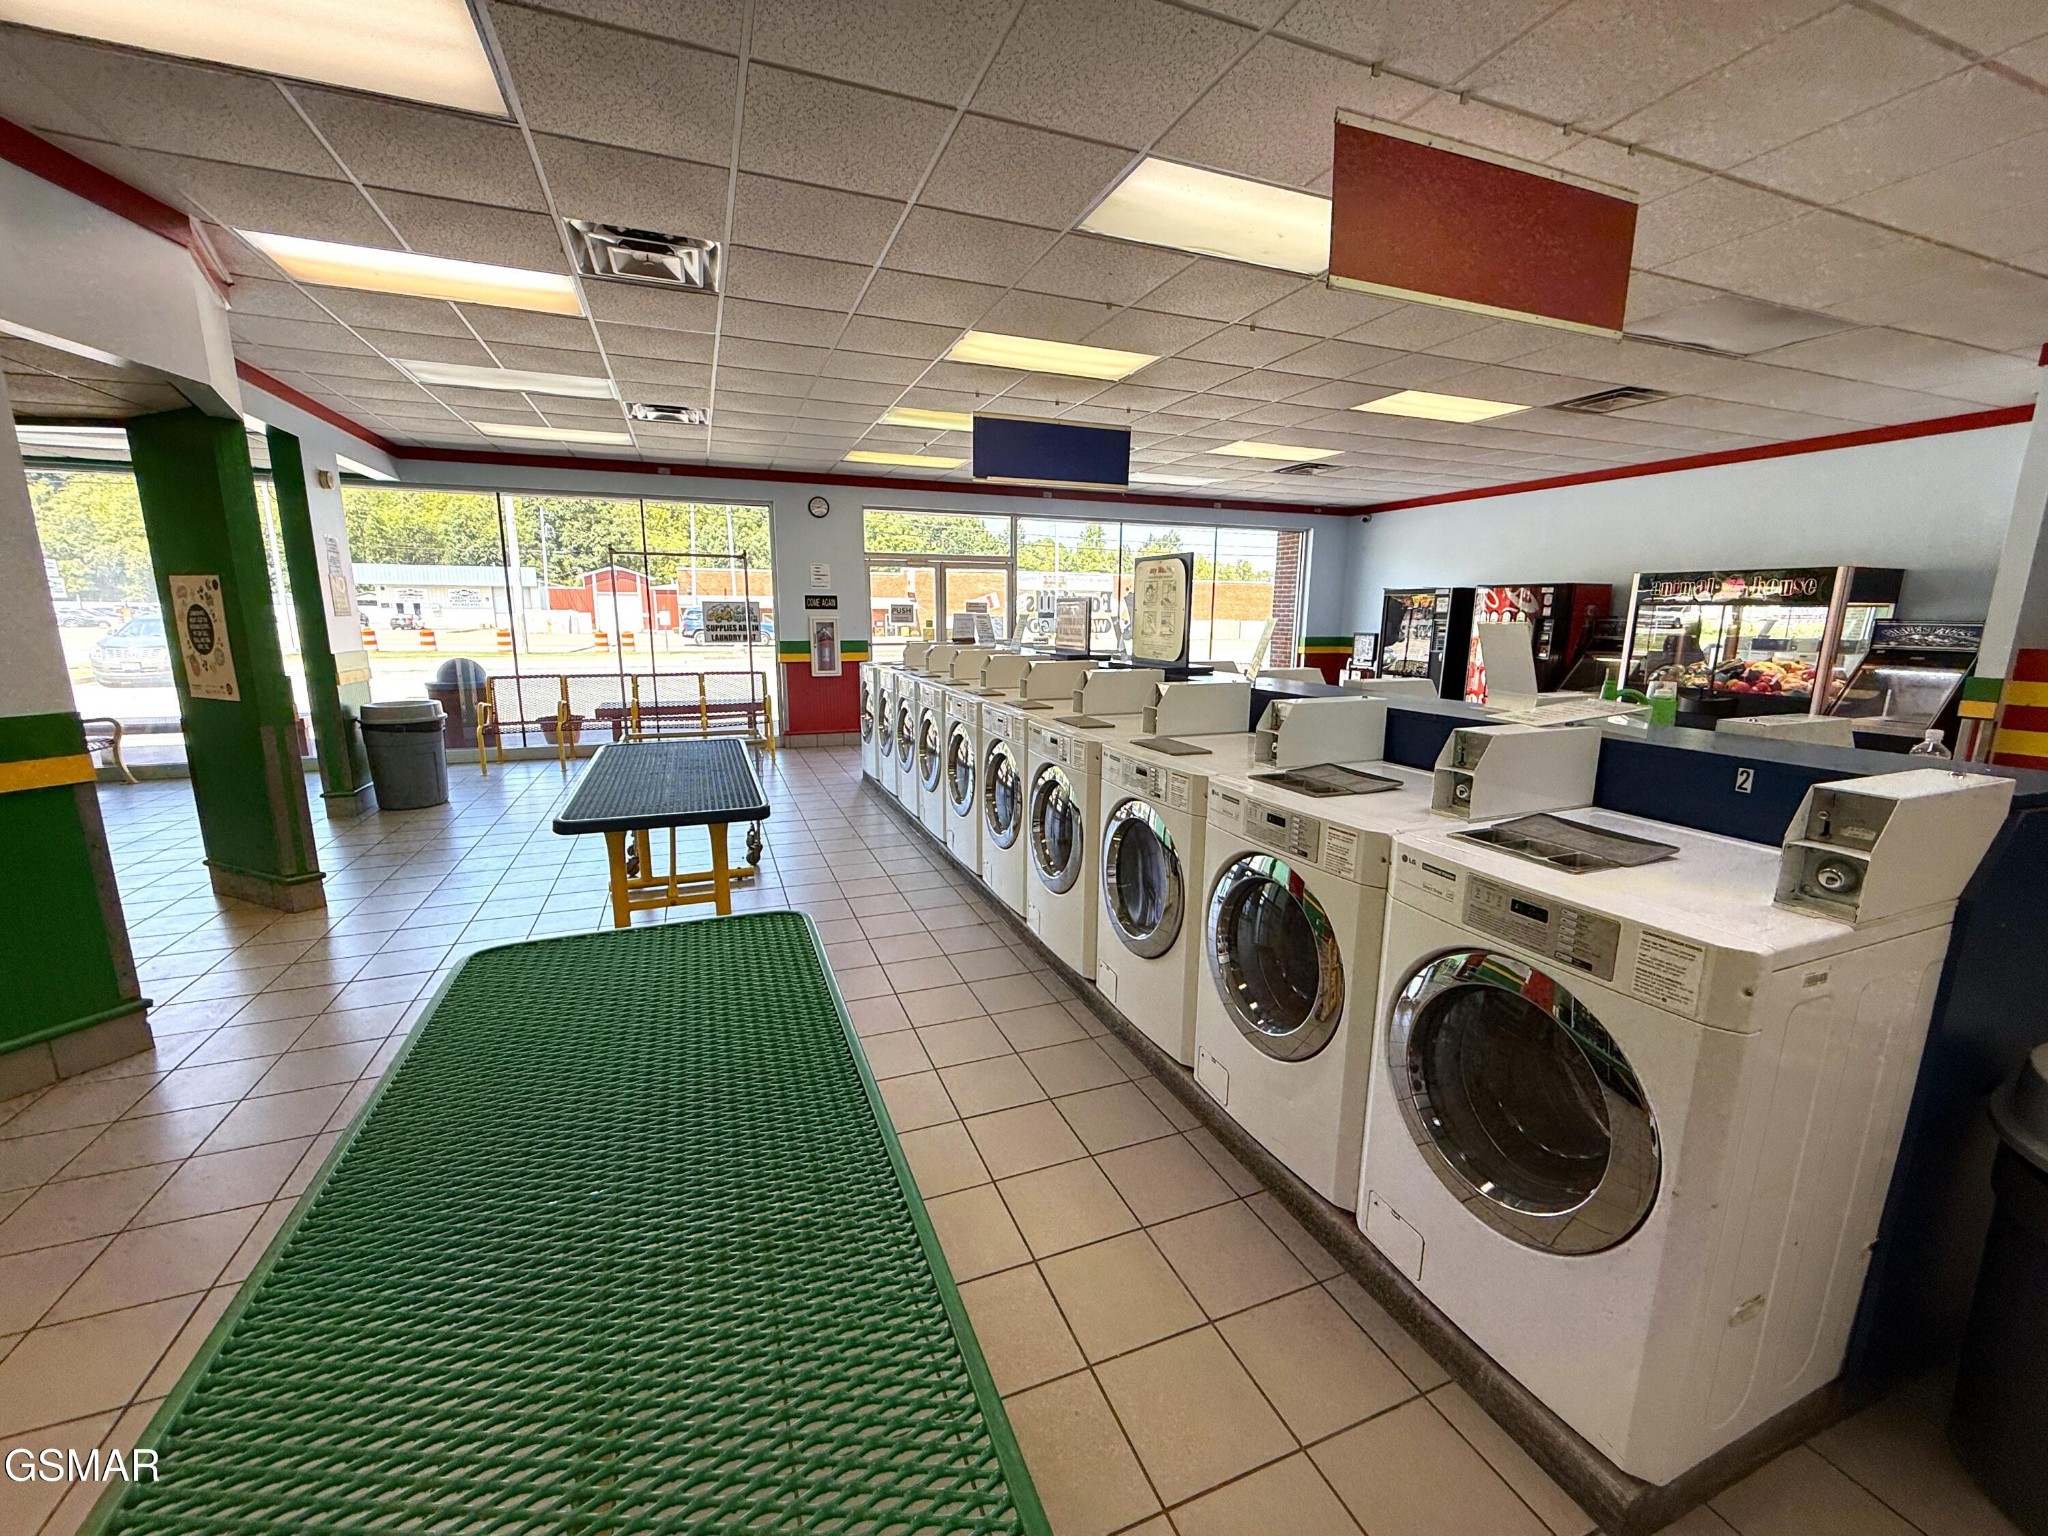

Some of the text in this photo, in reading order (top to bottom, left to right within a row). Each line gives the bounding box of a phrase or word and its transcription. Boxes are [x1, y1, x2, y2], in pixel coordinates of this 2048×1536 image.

[1651, 576, 1818, 597] animal house
[806, 598, 836, 607] COME AGAIN
[891, 607, 912, 615] PUSH
[706, 624, 737, 632] SUPPLIES
[752, 624, 759, 632] IN
[711, 634, 741, 642] LAUNDRY
[1736, 769, 1751, 792] 2
